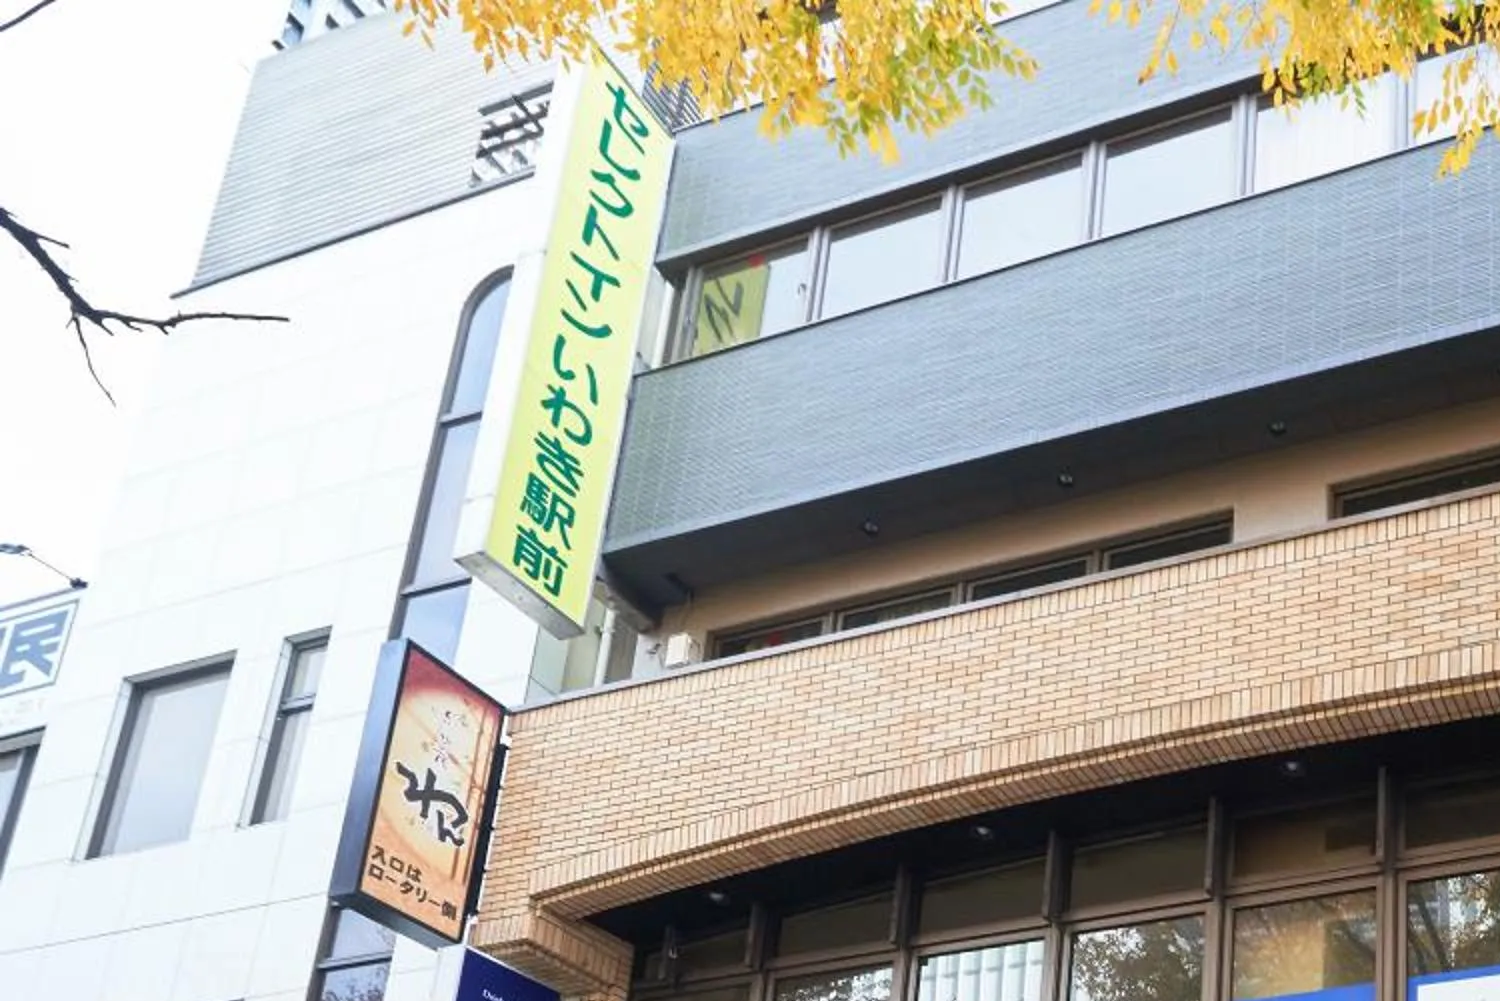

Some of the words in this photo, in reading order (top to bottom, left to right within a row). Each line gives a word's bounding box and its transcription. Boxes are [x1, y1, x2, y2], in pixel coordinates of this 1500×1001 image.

[0, 609, 69, 690] 民
[368, 864, 457, 920] ロータリー側
[371, 846, 422, 884] 入口は
